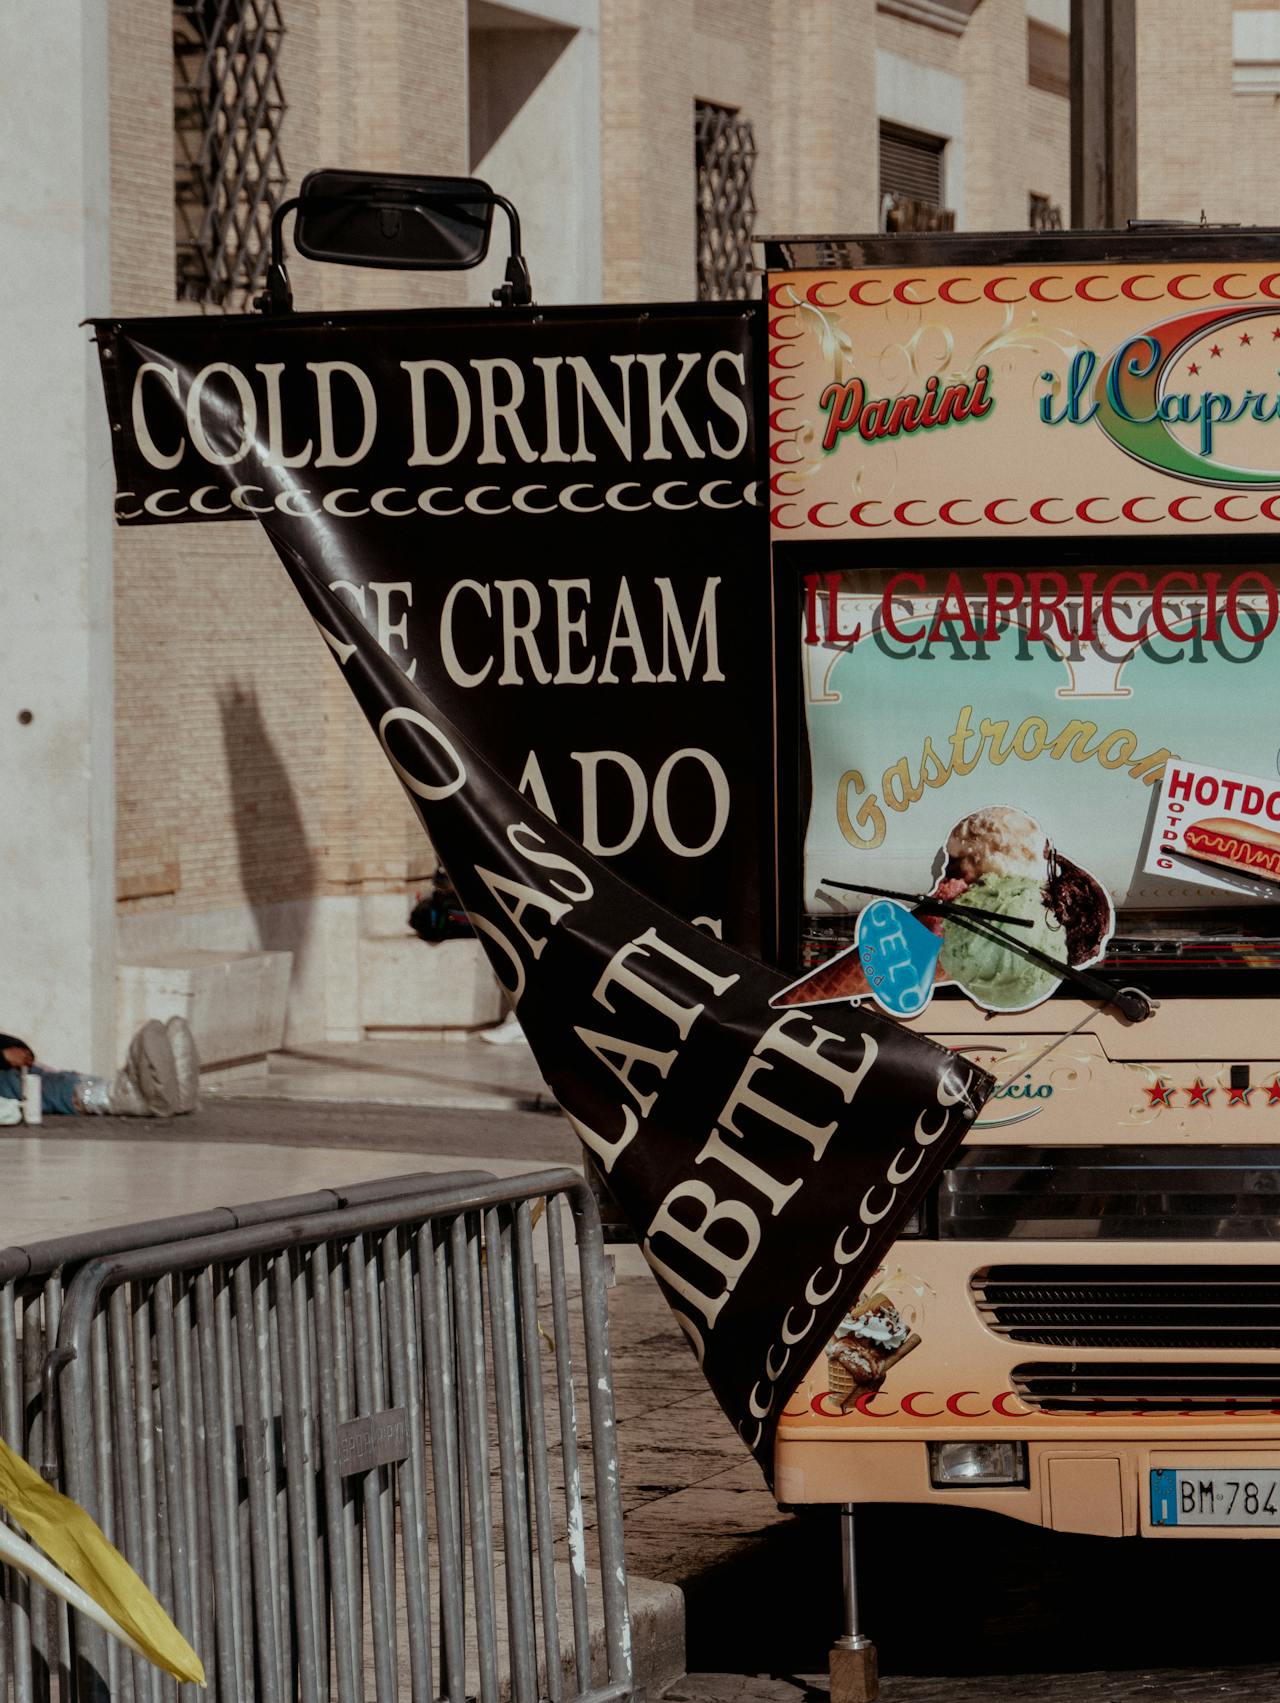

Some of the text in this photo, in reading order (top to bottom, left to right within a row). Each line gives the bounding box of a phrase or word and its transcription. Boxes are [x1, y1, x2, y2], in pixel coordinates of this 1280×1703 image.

[132, 351, 748, 470] COLD DRINKS
[820, 364, 993, 451] Panini
[1036, 350, 1099, 424] il
[440, 576, 725, 688] CREAM
[804, 571, 1279, 644] IL CAPRICCIO
[862, 945, 885, 987] food
[871, 901, 925, 1012] GELO
